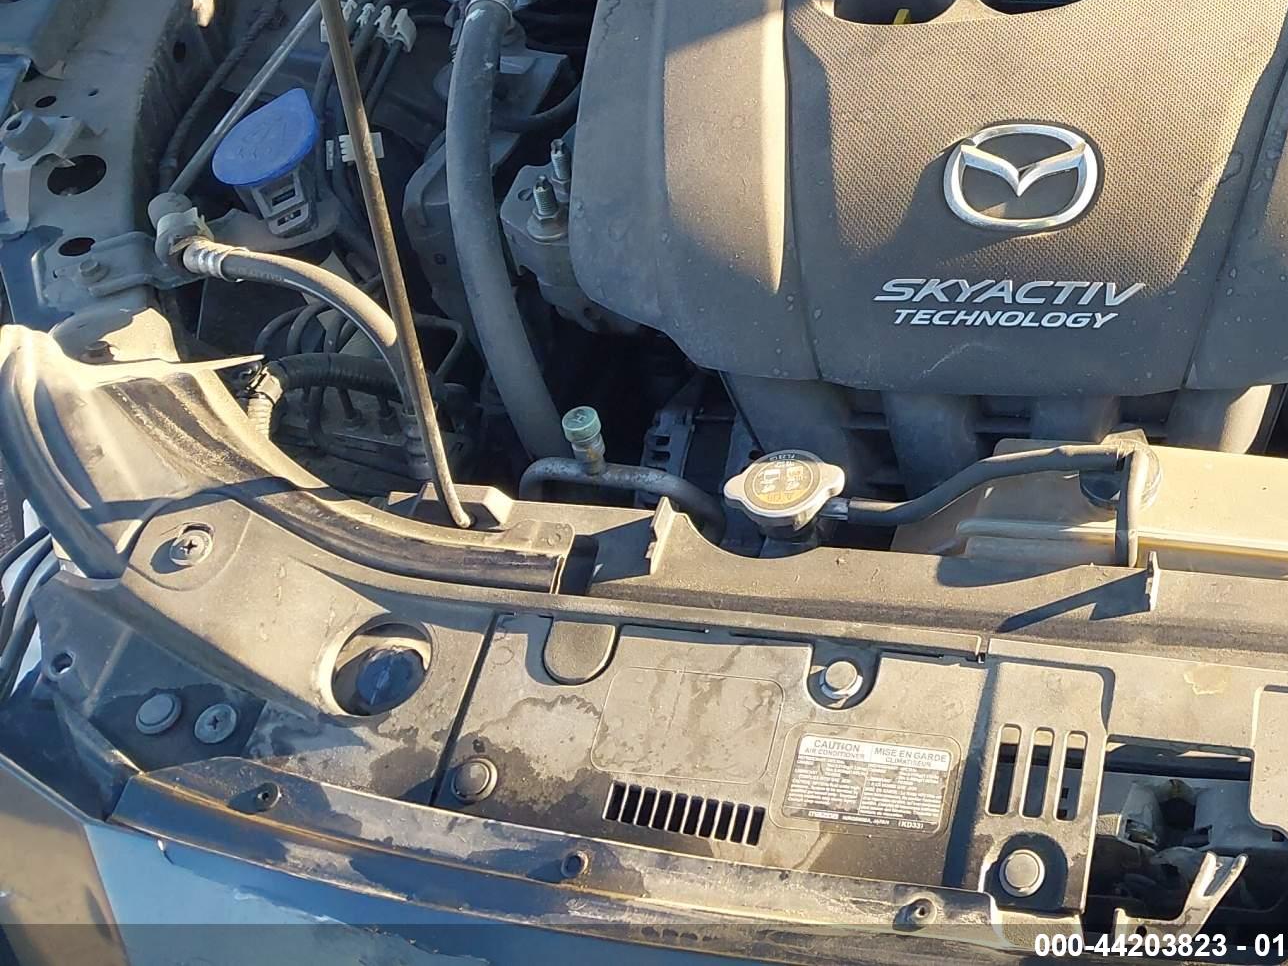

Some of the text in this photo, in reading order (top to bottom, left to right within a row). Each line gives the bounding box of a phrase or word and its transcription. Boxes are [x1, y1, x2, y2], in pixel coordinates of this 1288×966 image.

[873, 278, 1146, 307] SKYACTIV
[894, 309, 1119, 329] TECHNOLOGY
[814, 740, 861, 752] CAUTION
[874, 747, 948, 763] MISE EN GARDE
